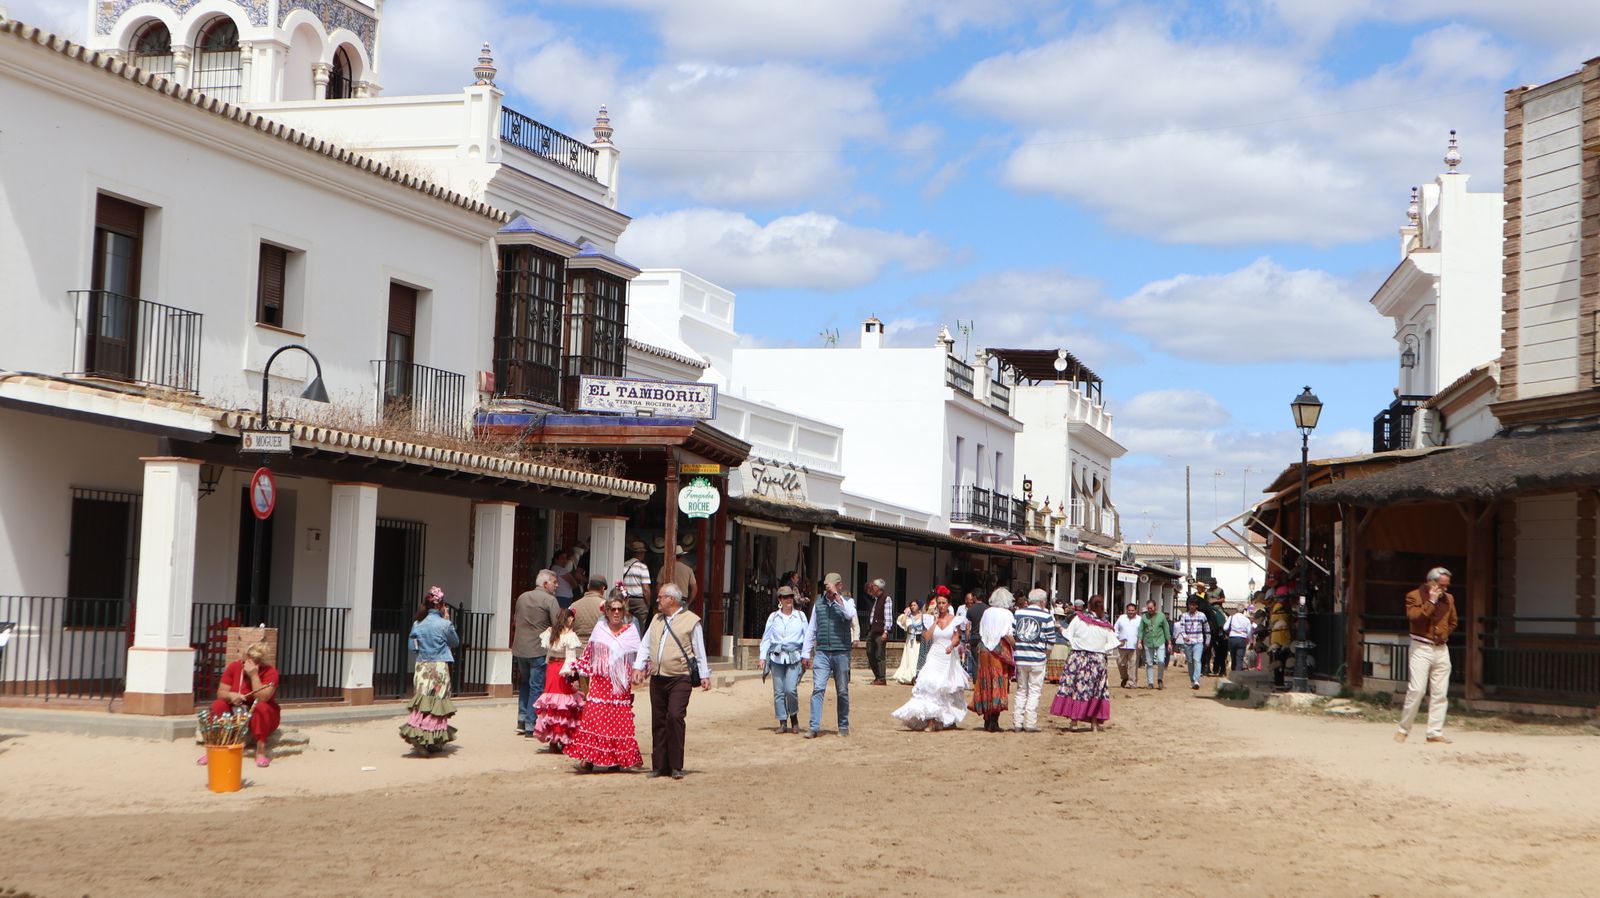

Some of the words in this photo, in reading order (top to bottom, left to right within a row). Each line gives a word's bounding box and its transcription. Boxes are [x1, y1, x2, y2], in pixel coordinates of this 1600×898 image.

[588, 384, 610, 397] EL
[616, 386, 705, 403] TAMBORIL
[256, 435, 282, 447] MOGUER
[688, 501, 710, 511] ROCHE
